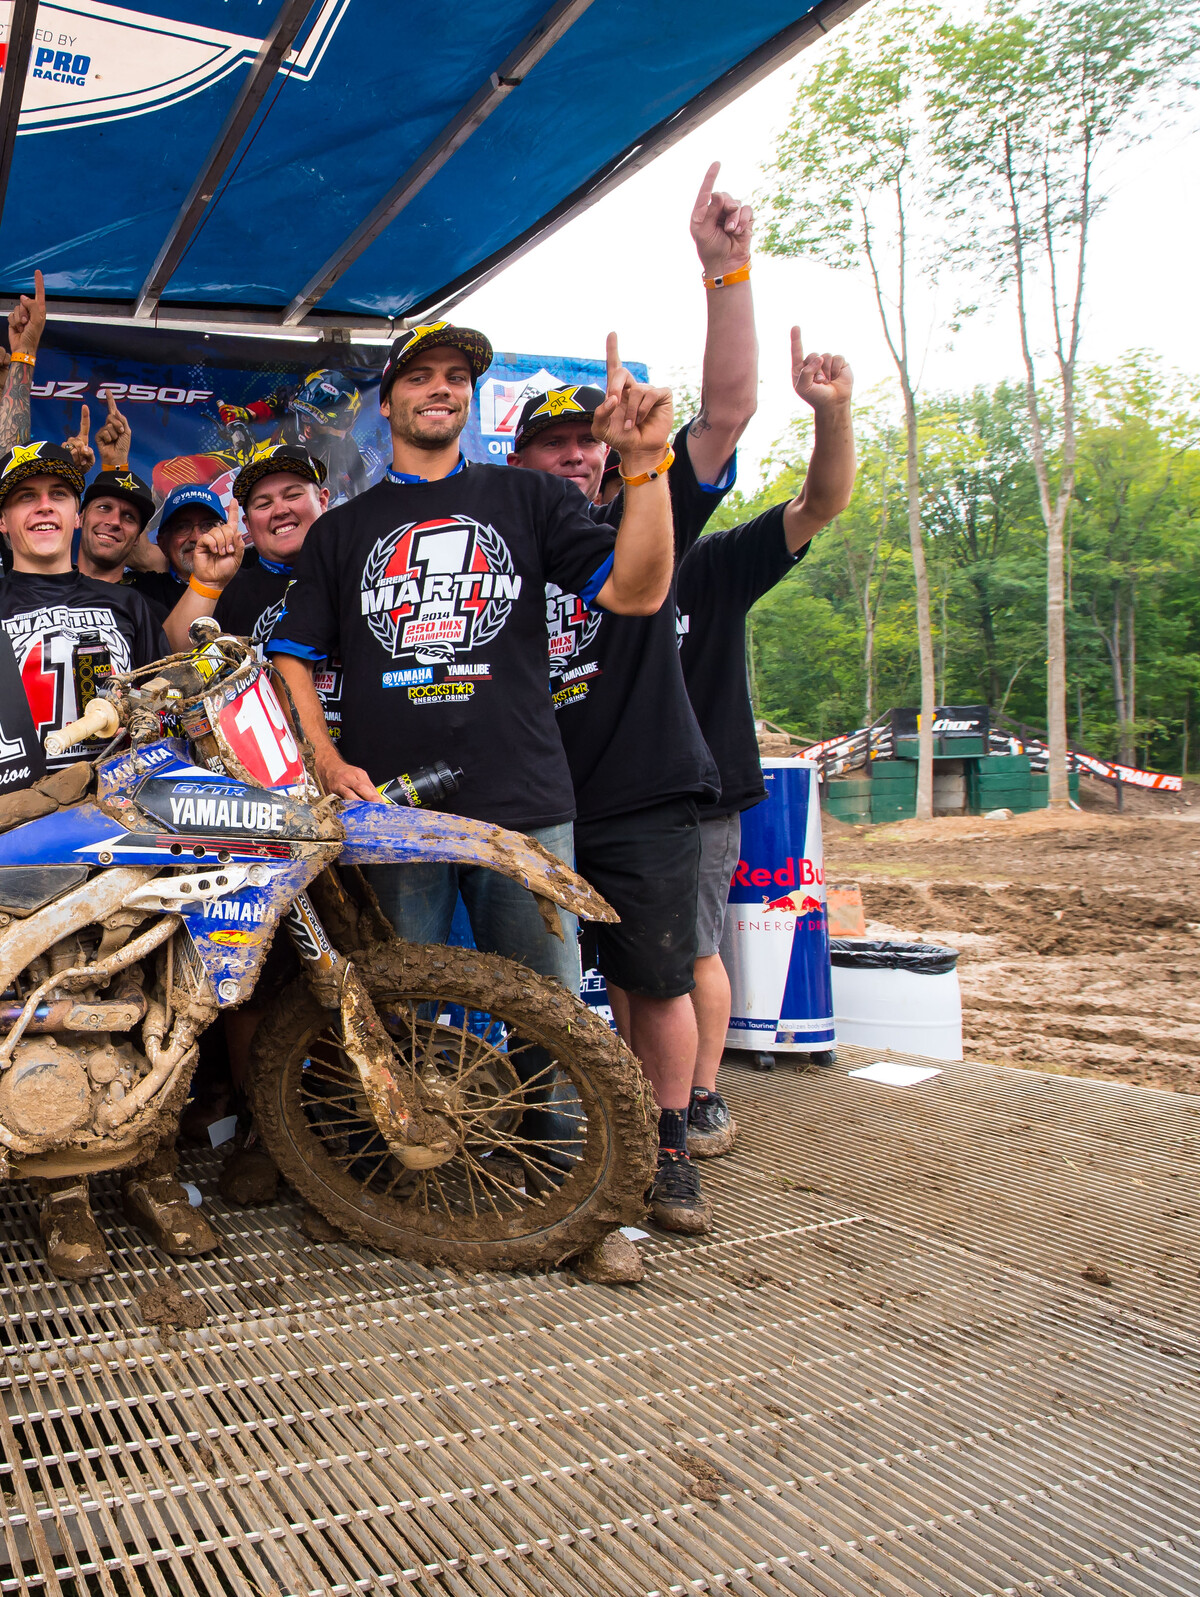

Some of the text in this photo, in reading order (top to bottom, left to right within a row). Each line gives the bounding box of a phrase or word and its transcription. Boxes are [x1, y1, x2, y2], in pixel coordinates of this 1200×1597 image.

[58, 34, 77, 47] BY
[35, 47, 91, 75] PRO
[32, 68, 86, 86] RACING
[31, 381, 214, 404] YZ 250F
[181, 491, 212, 502] YAMAHA
[375, 572, 413, 588] JEREMY
[361, 574, 522, 615] MARTIN
[5, 609, 112, 634] MARTIN
[421, 611, 450, 621] 2014
[406, 620, 463, 635] 250 MX
[404, 631, 462, 644] CHAMPION
[392, 668, 432, 682] YAMAHA
[447, 664, 490, 676] YAMALUBE
[561, 661, 599, 683] YAMALUBE
[414, 695, 443, 704] ENERGY
[234, 673, 298, 784] 19
[932, 718, 979, 732] thor
[171, 782, 250, 797] GYTR
[170, 797, 284, 830] YAMALUBE
[730, 857, 824, 887] Red Bu
[202, 900, 275, 922] YAMAHA
[738, 920, 804, 931] ENERGY
